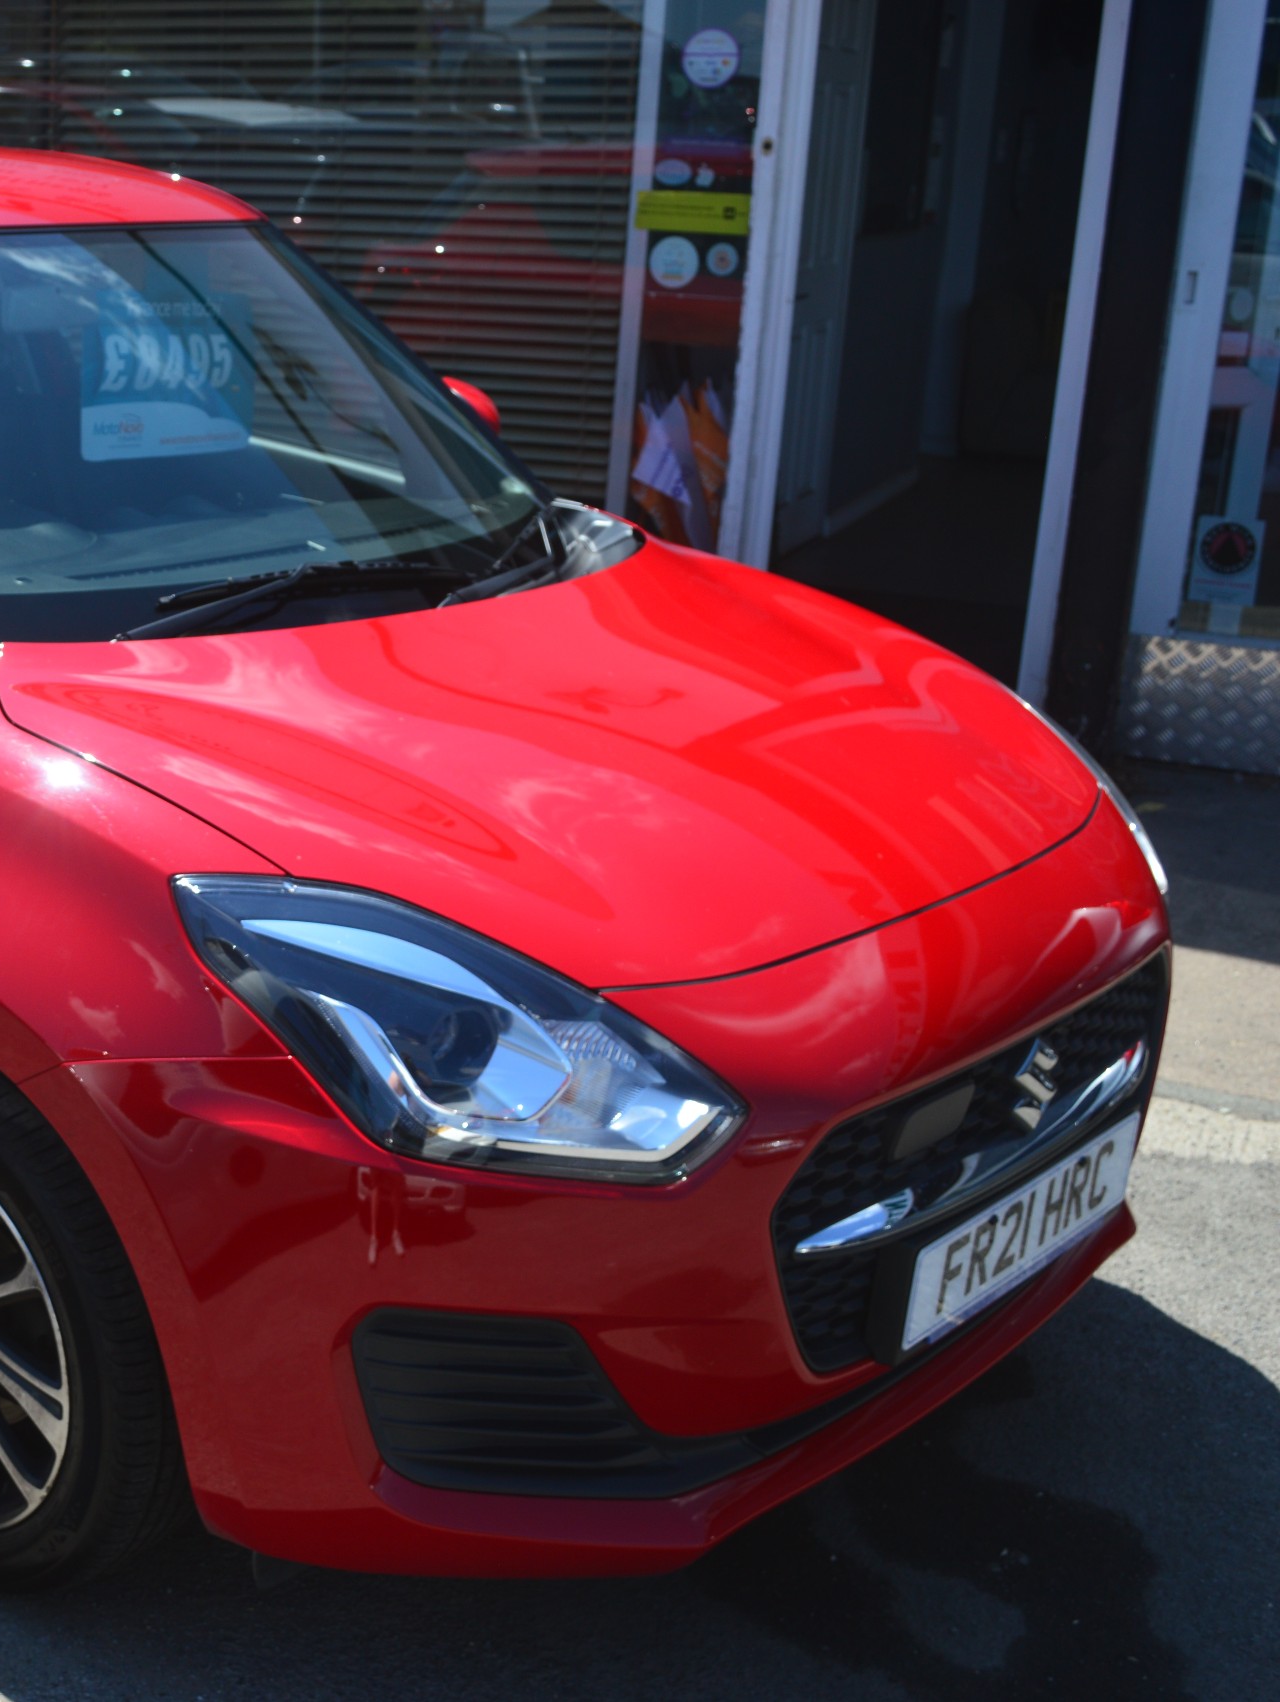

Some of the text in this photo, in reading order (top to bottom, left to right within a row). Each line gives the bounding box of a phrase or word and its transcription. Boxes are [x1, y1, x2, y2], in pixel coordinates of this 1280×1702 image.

[99, 333, 232, 391] £8495
[936, 1140, 1115, 1315] FR21 HRC
